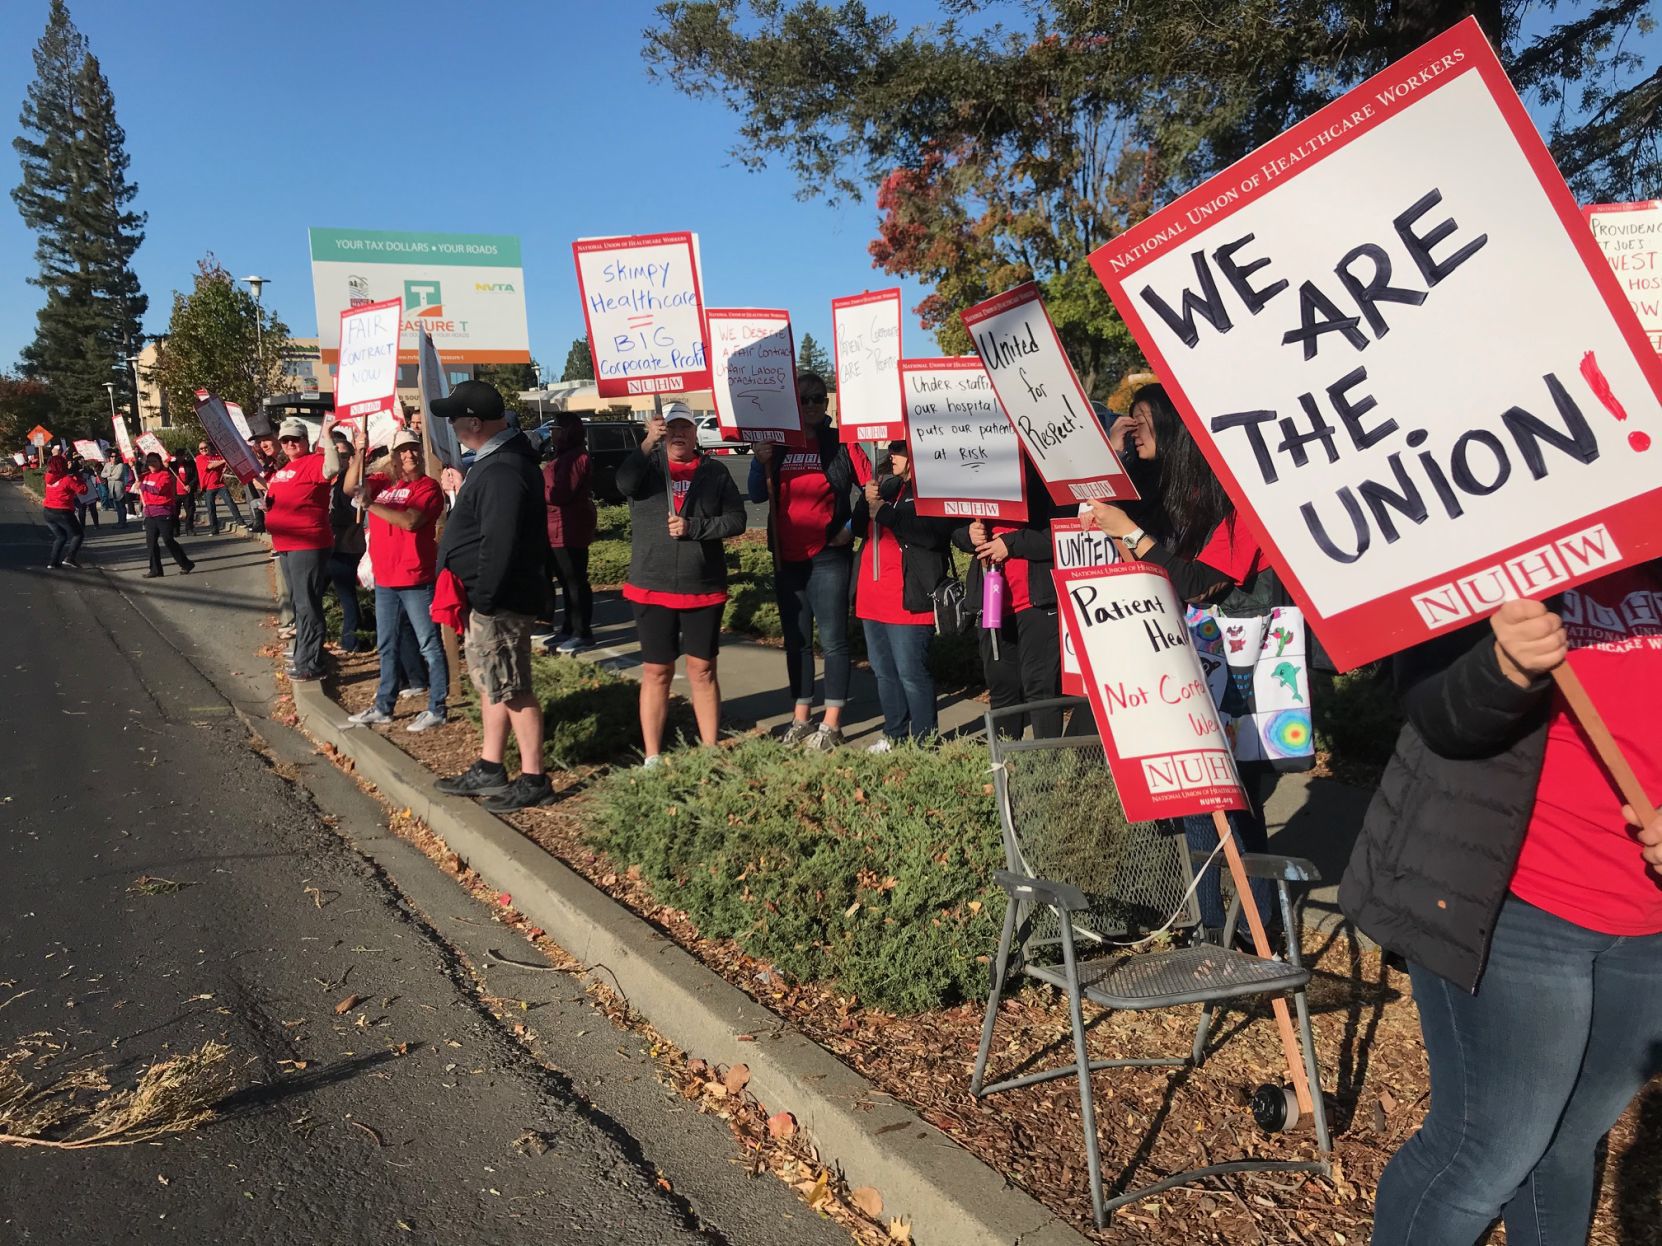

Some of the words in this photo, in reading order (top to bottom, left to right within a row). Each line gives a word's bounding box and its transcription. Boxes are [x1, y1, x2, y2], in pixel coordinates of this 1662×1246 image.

[1108, 220, 1187, 273] NATIONAL
[1186, 188, 1239, 226] UNION
[1240, 173, 1262, 193] OF
[1261, 103, 1375, 181] HEALTHCARE
[1375, 47, 1466, 108] WORKERS
[335, 239, 364, 250] YOUR
[364, 240, 384, 251] TAX
[385, 241, 429, 252] DOLLARS
[437, 243, 466, 254] YOUR
[466, 244, 498, 255] ROADS
[577, 243, 603, 251] NATIONAL
[603, 241, 620, 249] UNION
[628, 238, 662, 247] HEALTHCARE
[1281, 187, 1489, 361] ARE
[474, 282, 515, 293] NVTA
[1139, 232, 1290, 350] WE
[590, 288, 702, 313] Healthcare
[348, 315, 389, 344] FAIR
[459, 320, 469, 332] T
[613, 326, 674, 353] BIG
[979, 322, 1040, 371] United
[341, 343, 394, 367] CONTRACT
[600, 352, 669, 376] Corporate
[351, 368, 381, 387] NOW
[628, 377, 683, 394] NUHW
[1018, 366, 1048, 403] for
[945, 397, 999, 417] hospital
[742, 430, 785, 443] NUHW
[916, 424, 945, 443] puts
[979, 421, 1016, 440] patient
[1017, 393, 1084, 461] Respect!
[1210, 365, 1400, 485] THE
[934, 448, 947, 460] at
[1069, 480, 1116, 500] NUHW
[944, 502, 999, 516] NUHW
[1071, 568, 1105, 579] NATIONAL
[1104, 567, 1128, 576] UNION
[1416, 527, 1612, 627] NUHW
[1070, 585, 1166, 628] Patient
[1566, 625, 1629, 643] ATIONAL
[1104, 682, 1149, 715] Not
[1145, 755, 1234, 788] NUH
[1152, 794, 1181, 803] NATIONAL
[1181, 790, 1202, 798] UNION
